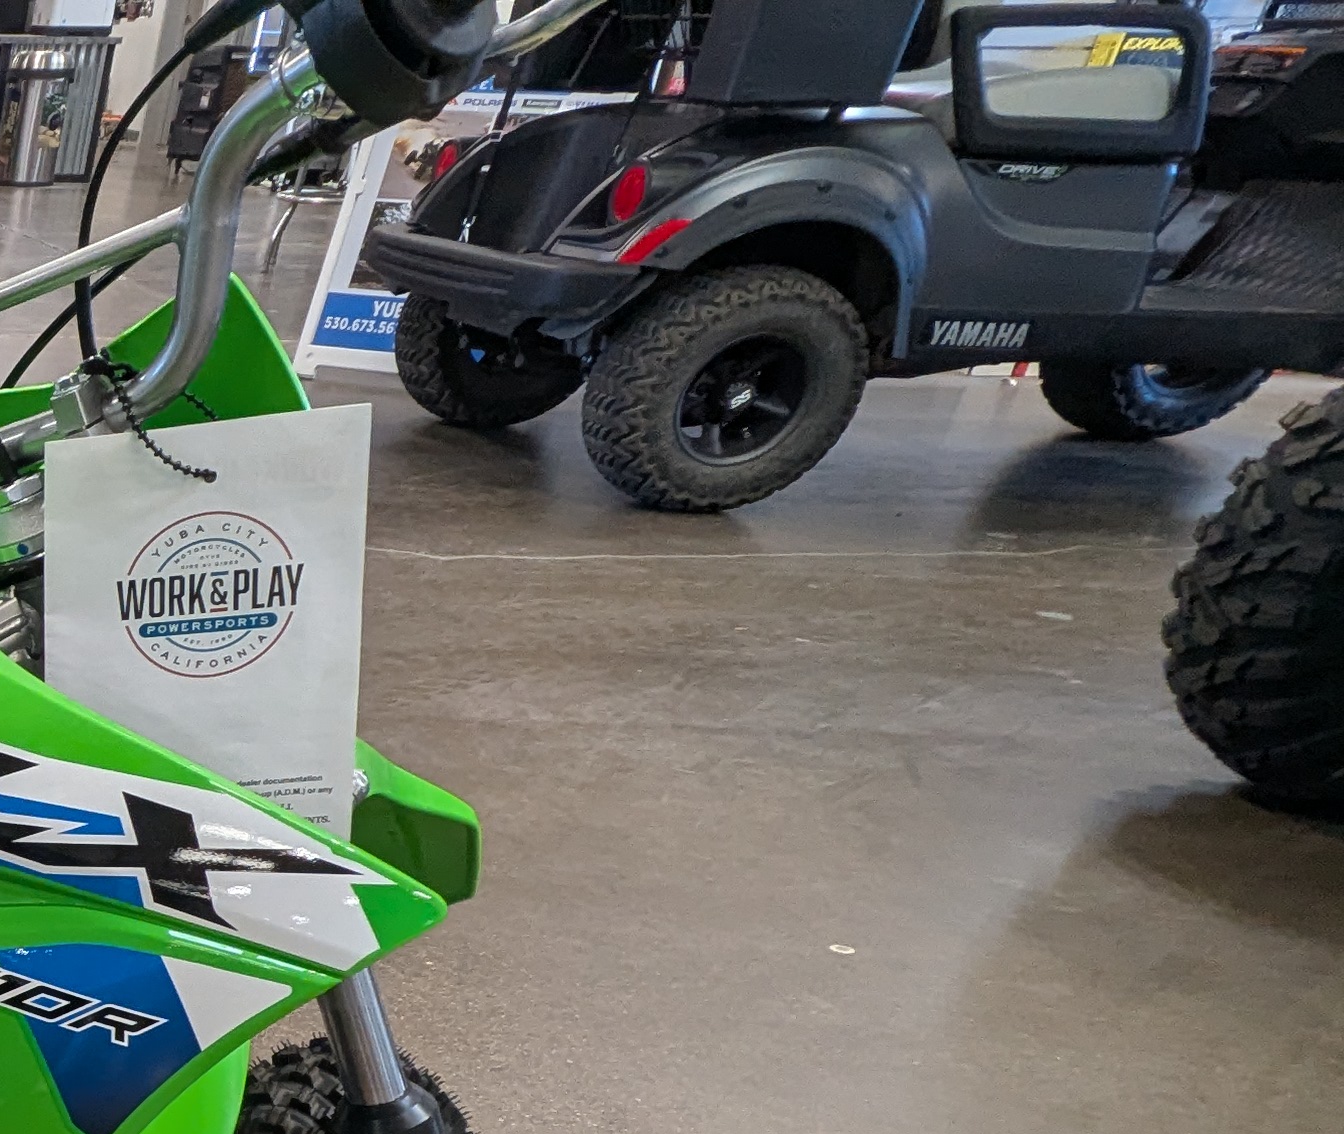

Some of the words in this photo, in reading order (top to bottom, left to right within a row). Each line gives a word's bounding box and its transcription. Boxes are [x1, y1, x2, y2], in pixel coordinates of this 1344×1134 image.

[463, 98, 518, 107] POLARS
[323, 316, 399, 334] 530.673.56
[929, 319, 1031, 348] YAMAHA
[150, 523, 205, 559] YUBA
[221, 522, 269, 548] CITY
[146, 614, 270, 635] POWERSPORTS
[150, 634, 268, 669] CALIFORNIA
[262, 774, 323, 786] documentation
[317, 786, 334, 795] any
